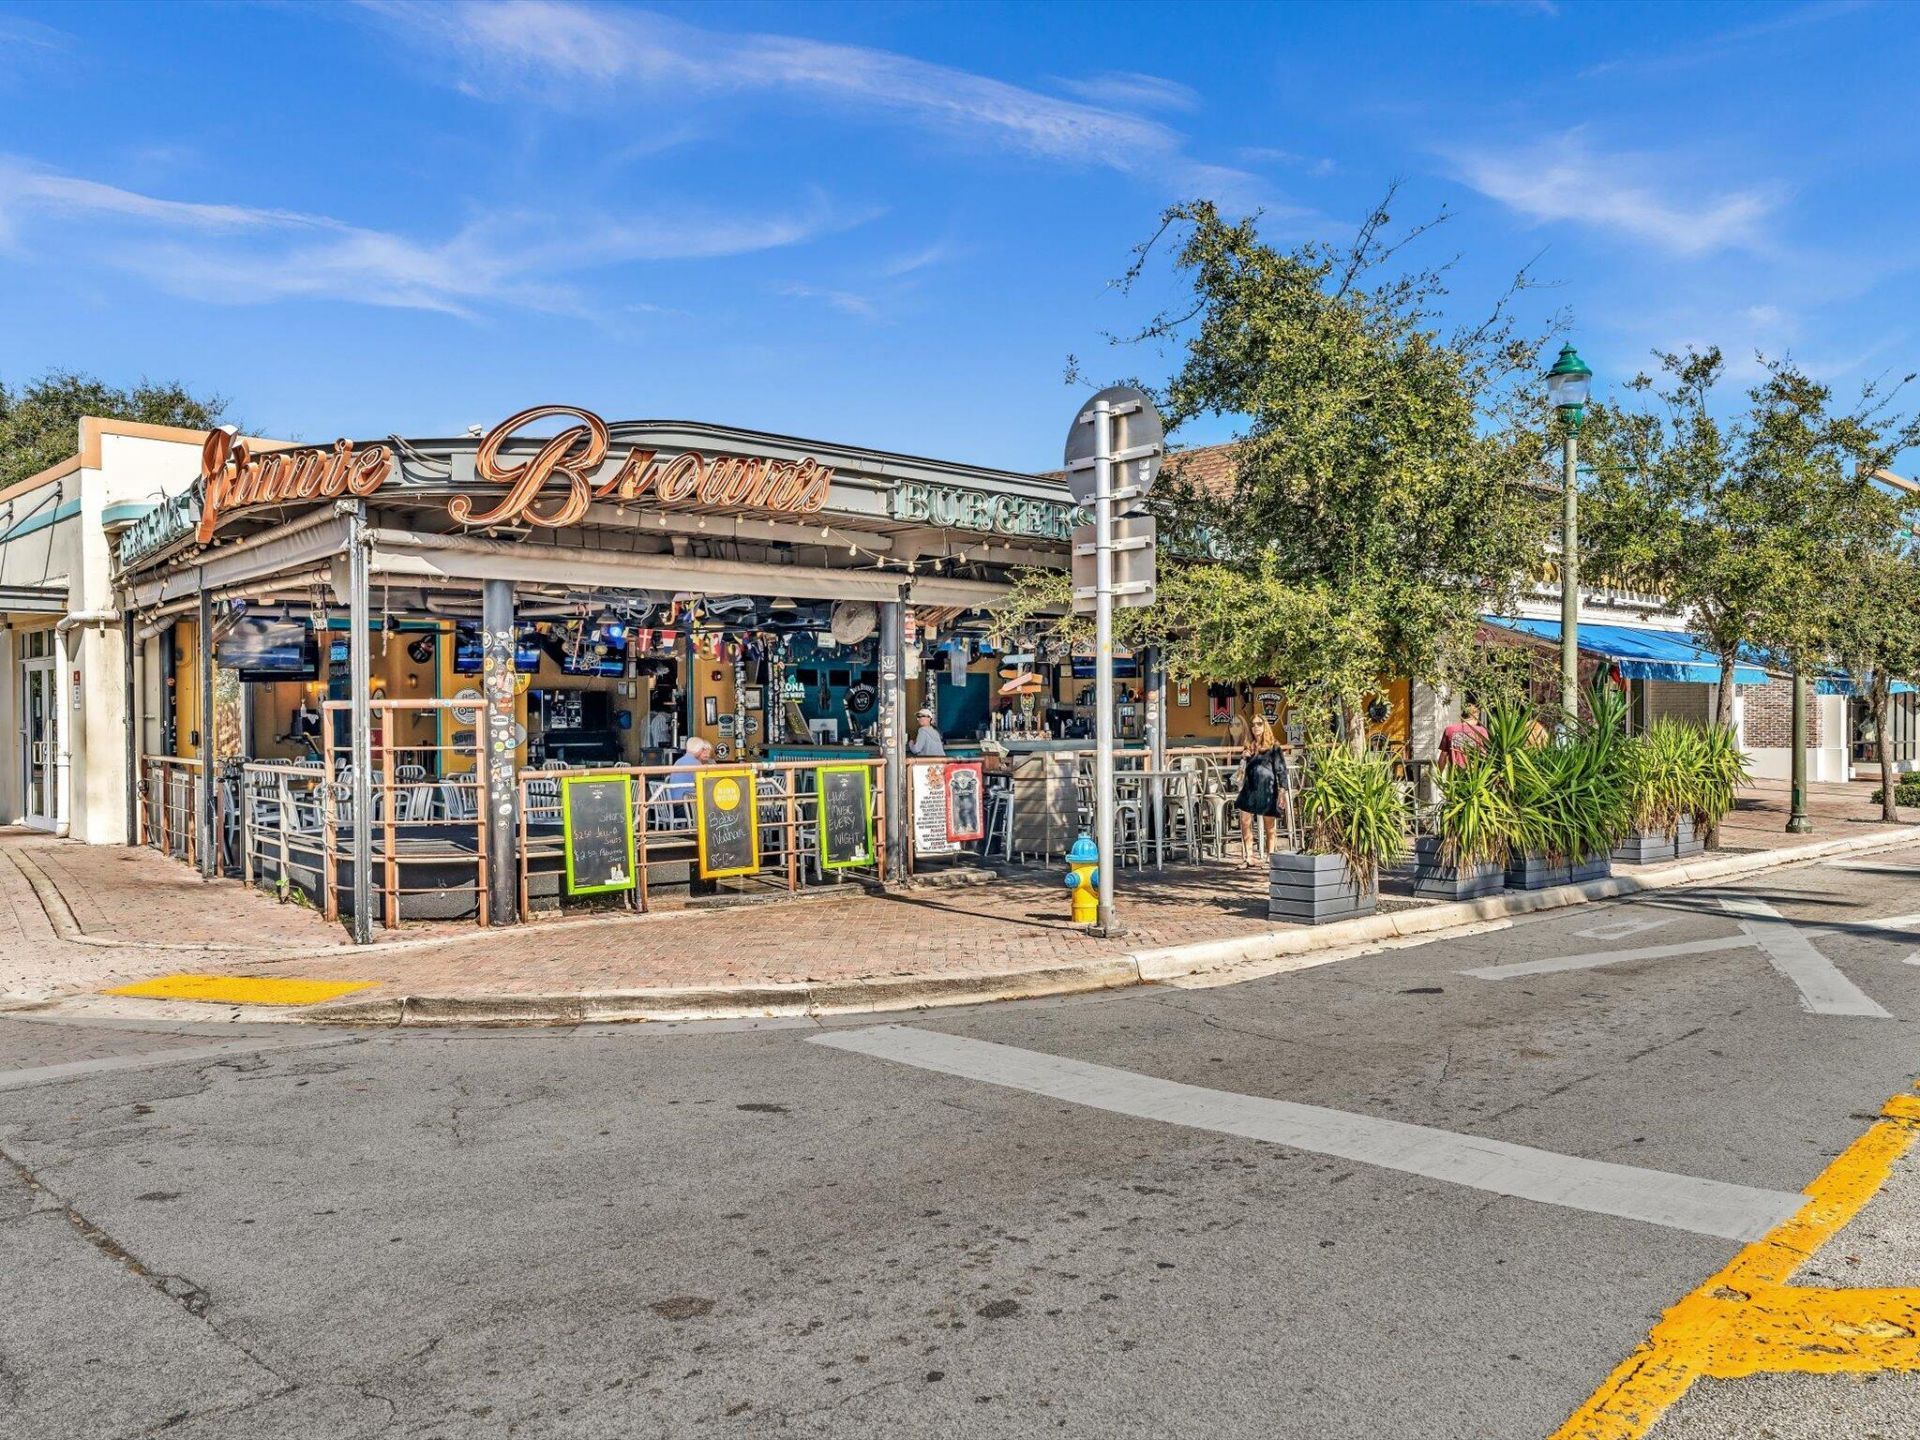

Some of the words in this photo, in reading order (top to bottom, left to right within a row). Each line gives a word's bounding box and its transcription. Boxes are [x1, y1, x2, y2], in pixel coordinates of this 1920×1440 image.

[447, 404, 836, 528] Brown's
[784, 682, 805, 692] ONA
[826, 789, 848, 802] LIVE
[827, 815, 856, 831] EVERY
[834, 832, 861, 847] NIGHT
